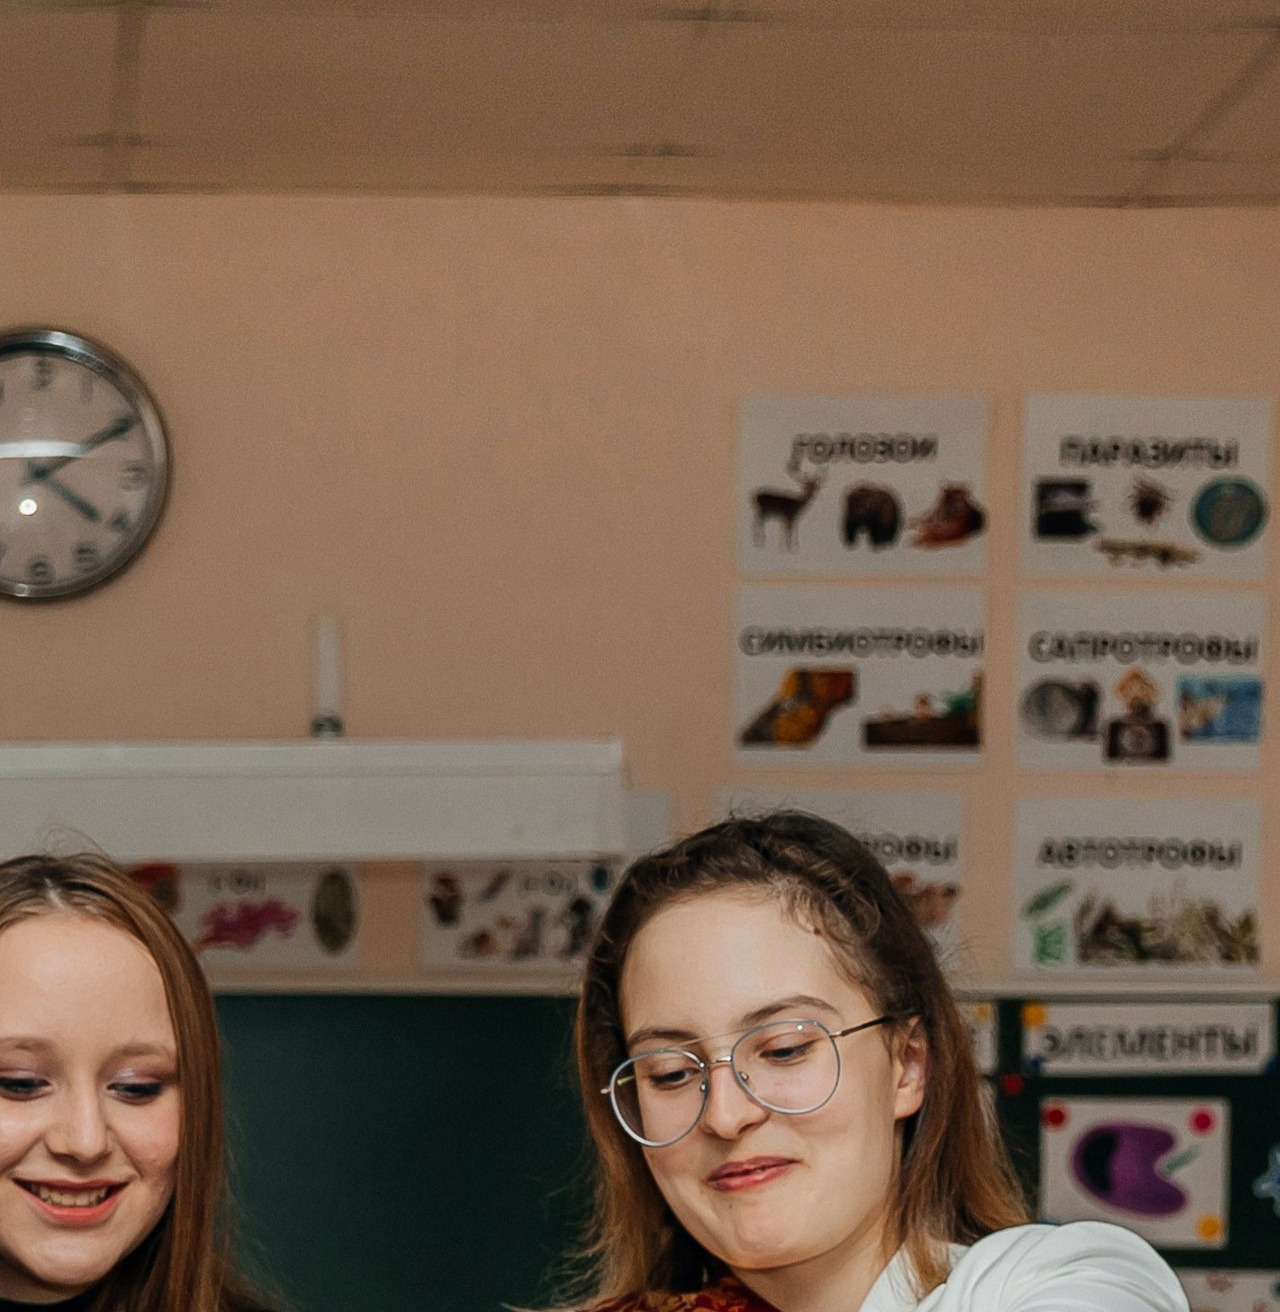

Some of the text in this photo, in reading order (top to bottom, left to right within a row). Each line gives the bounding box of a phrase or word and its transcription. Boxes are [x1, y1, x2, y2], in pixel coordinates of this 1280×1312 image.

[1059, 435, 1239, 467] ПАРАЗИТЫ
[1028, 631, 1259, 662] САПРОТРОФЫ
[1036, 837, 1242, 868] АВТОТРОФЫ
[1044, 1024, 1258, 1060] ЭЛЕМЕНТЫ
